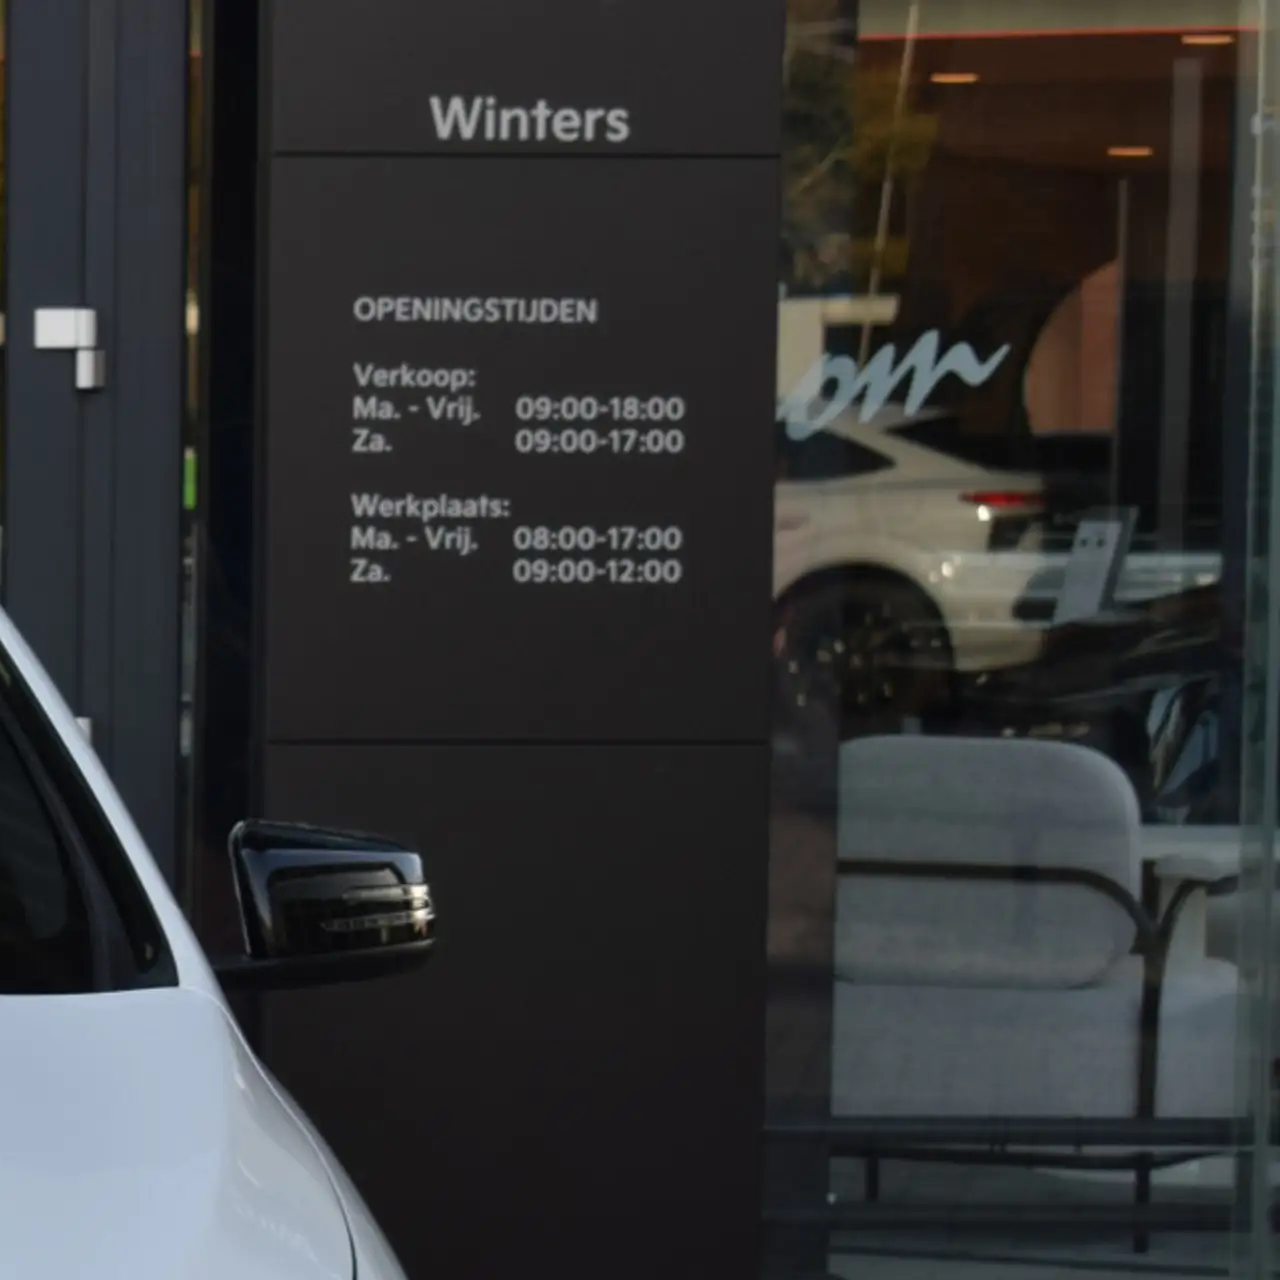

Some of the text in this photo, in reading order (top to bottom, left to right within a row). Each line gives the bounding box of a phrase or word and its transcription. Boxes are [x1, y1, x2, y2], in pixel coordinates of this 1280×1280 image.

[429, 95, 630, 142] Winters
[353, 297, 598, 323] OPENINGSTIJDEN
[353, 363, 476, 392] Verkoop:
[352, 396, 401, 420] Ma.
[426, 395, 481, 425] Vrij.
[515, 396, 685, 421] 09:00-18:00
[352, 428, 685, 454] Za. 09:00-17:00
[350, 494, 510, 522] Werkplaats:
[350, 525, 398, 550] Ma.
[425, 525, 478, 556] Vrij.
[513, 526, 683, 551] 08:00-17:00
[350, 558, 682, 584] Za. 09:00-12:00
